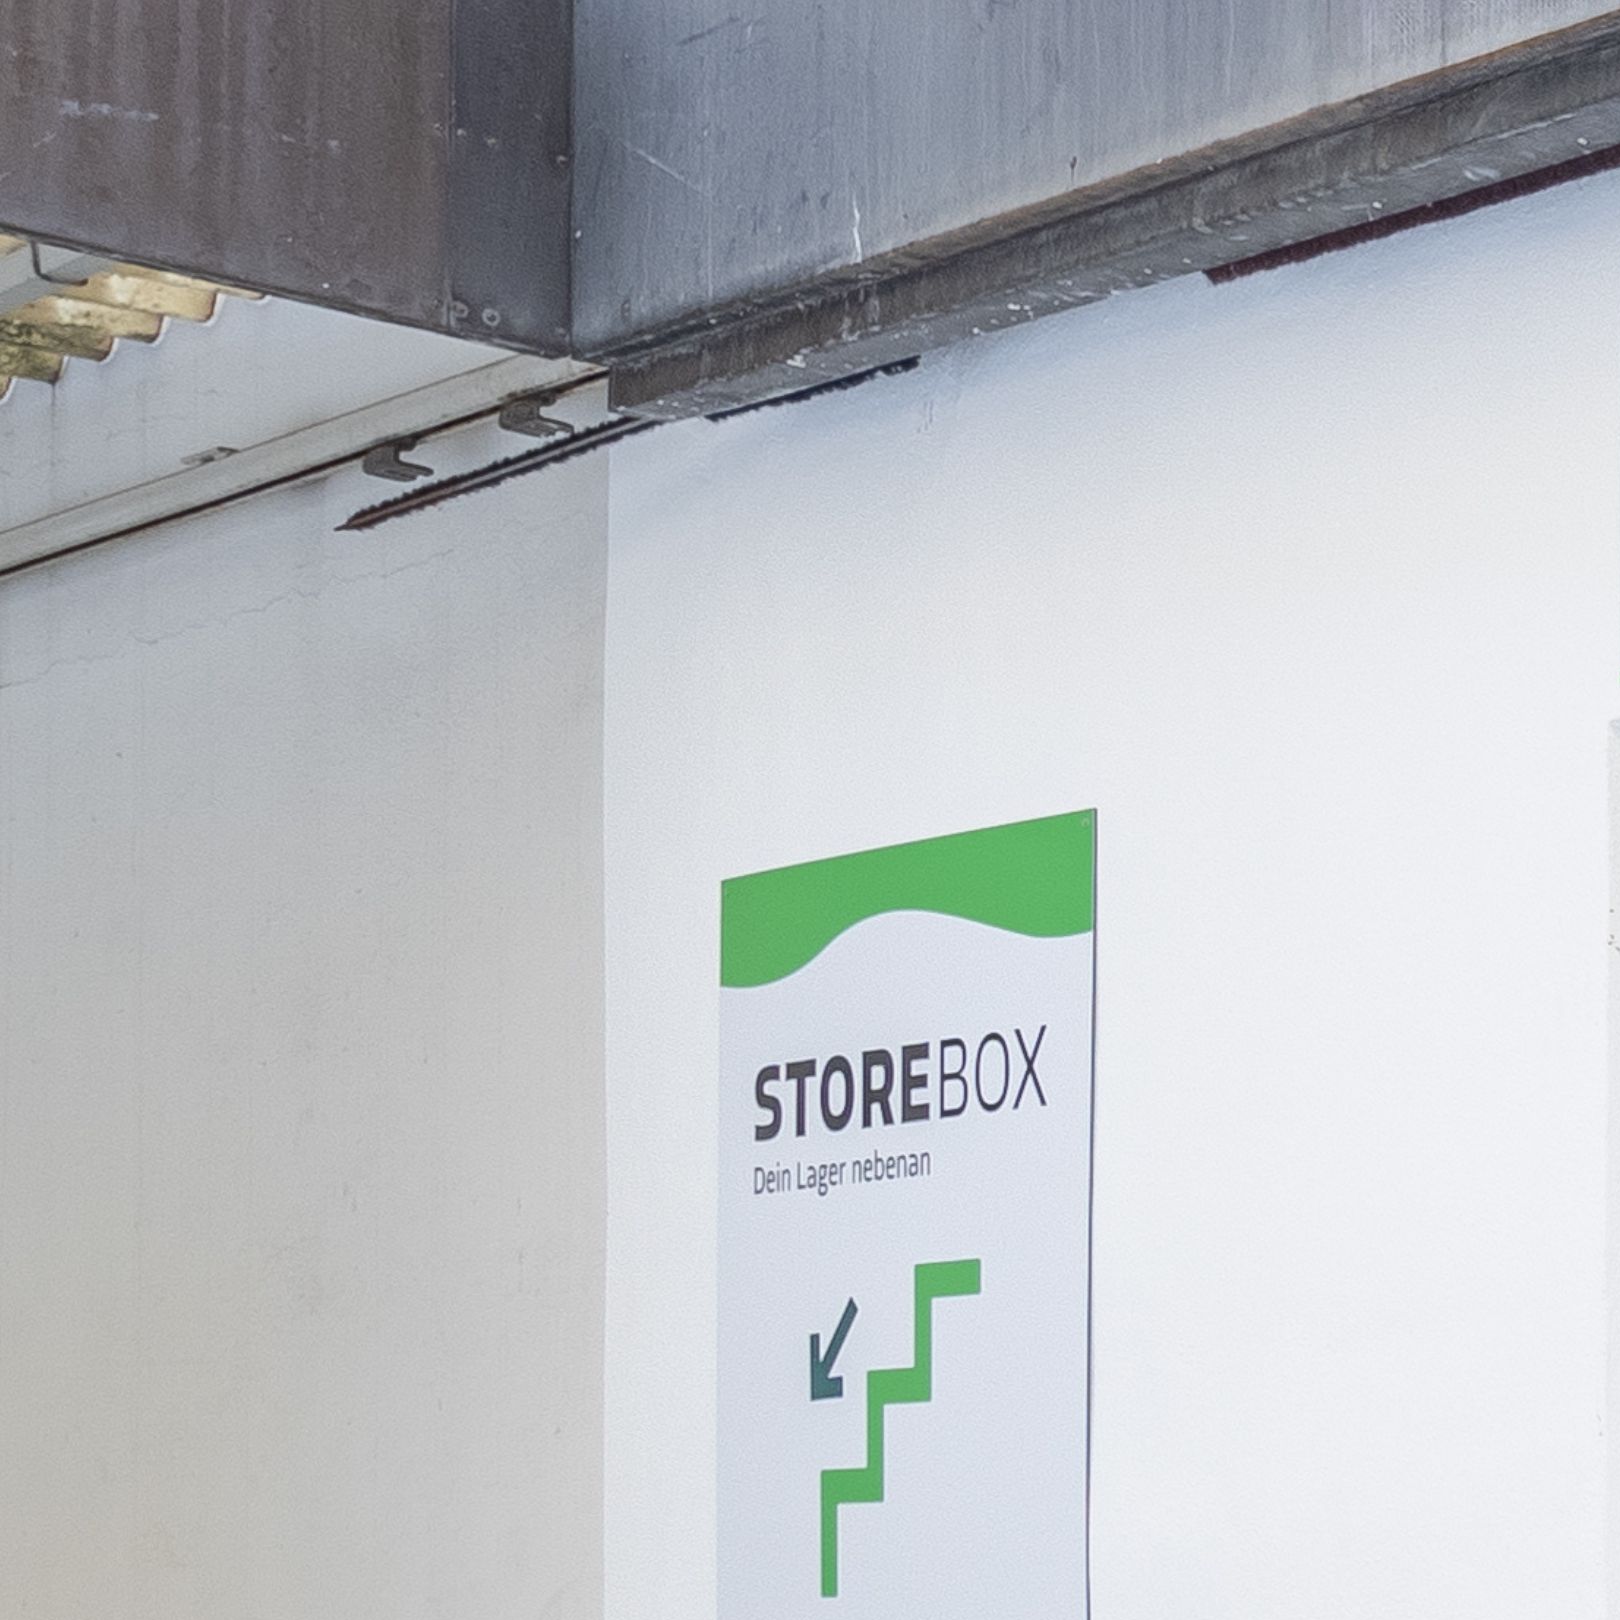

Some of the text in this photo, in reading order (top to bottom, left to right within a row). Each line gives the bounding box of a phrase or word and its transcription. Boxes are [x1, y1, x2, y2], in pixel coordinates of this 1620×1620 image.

[755, 1025, 1046, 1141] STOREBOX
[754, 1150, 930, 1196] Dein Lager nebenan
